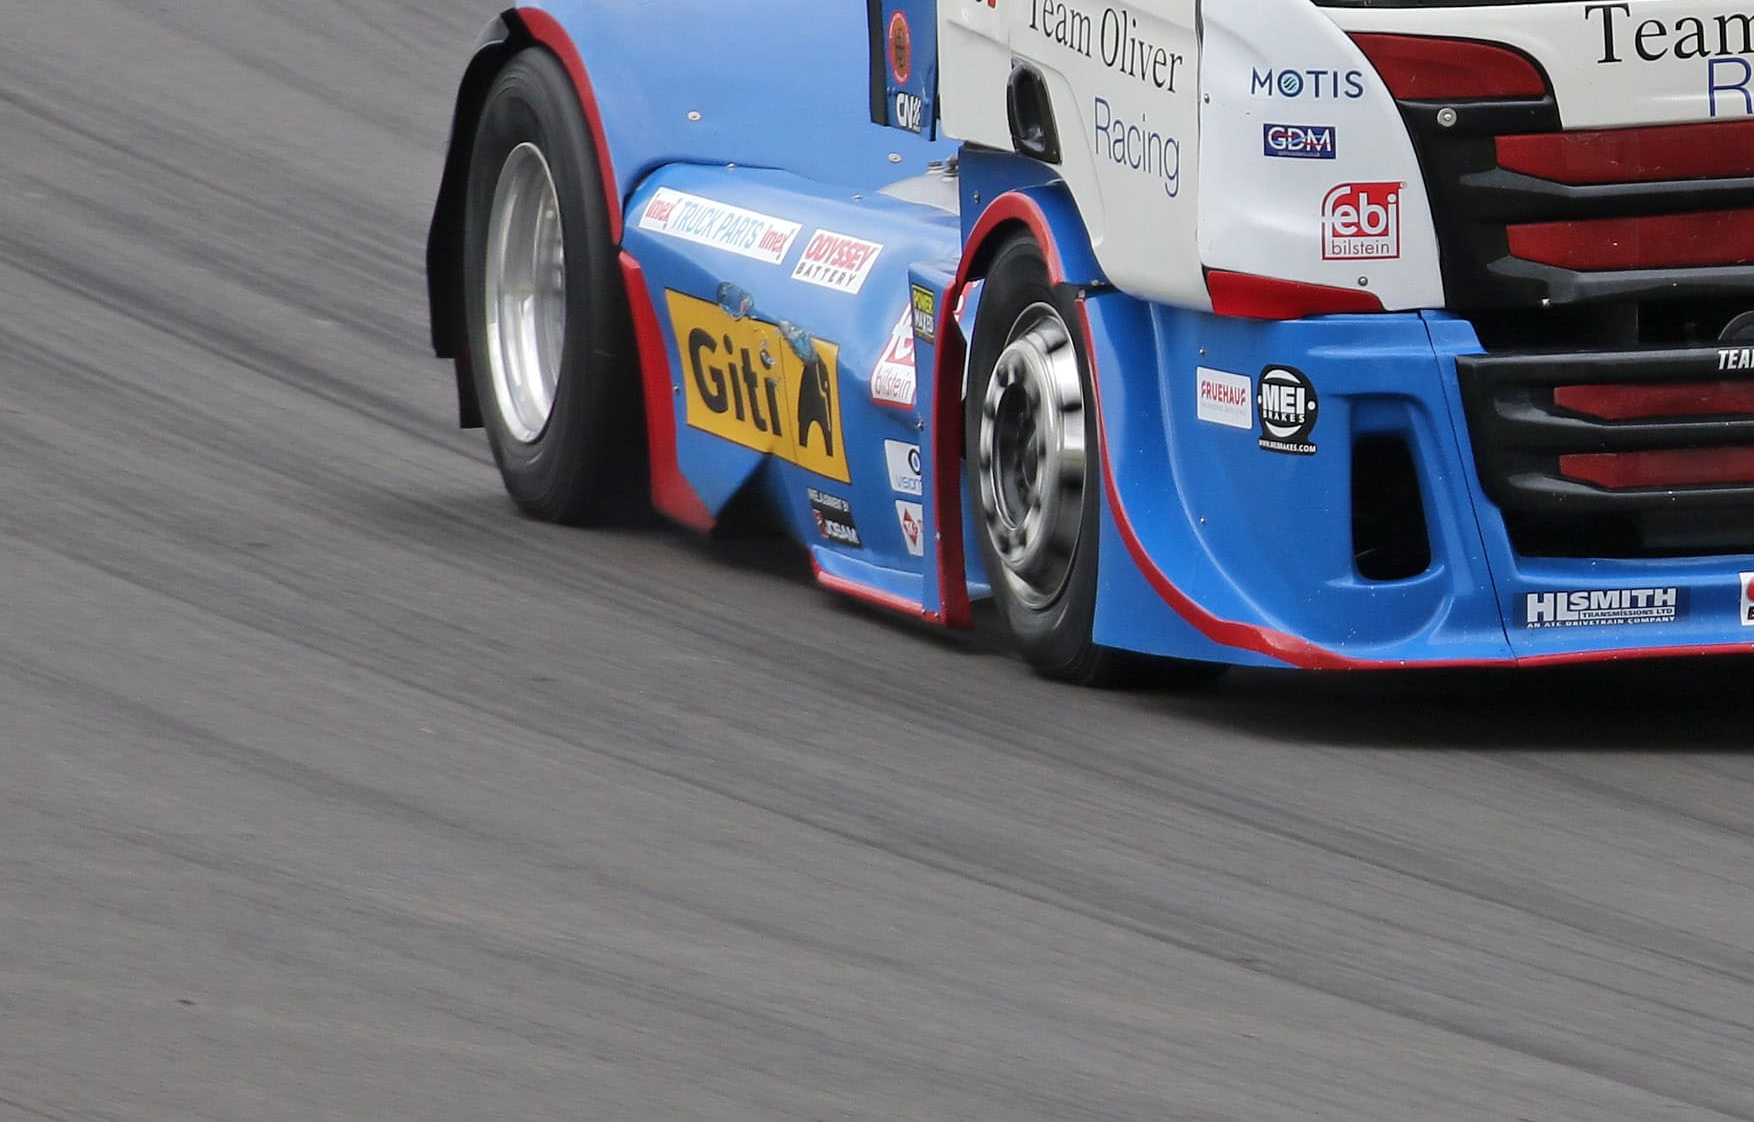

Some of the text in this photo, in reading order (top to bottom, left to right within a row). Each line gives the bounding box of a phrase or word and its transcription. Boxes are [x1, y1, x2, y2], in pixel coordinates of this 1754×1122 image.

[1100, 7, 1184, 94] Oliver
[1250, 66, 1364, 99] MOTIS
[1094, 96, 1180, 198] Racing
[1267, 126, 1332, 152] GDM
[1321, 185, 1398, 236] febi
[805, 233, 877, 272] ODYSSEY
[1331, 239, 1390, 255] bilstein
[795, 261, 857, 287] BATTERY
[688, 326, 783, 438] Giti
[1201, 380, 1247, 406] FRUEHAUF
[1262, 383, 1305, 415] MEI
[1263, 410, 1305, 423] BRAKES
[1565, 618, 1624, 627] DRIVETRAIN
[1627, 616, 1675, 624] COMPANY
[1582, 608, 1673, 619] TRANSMISSIONS LTD
